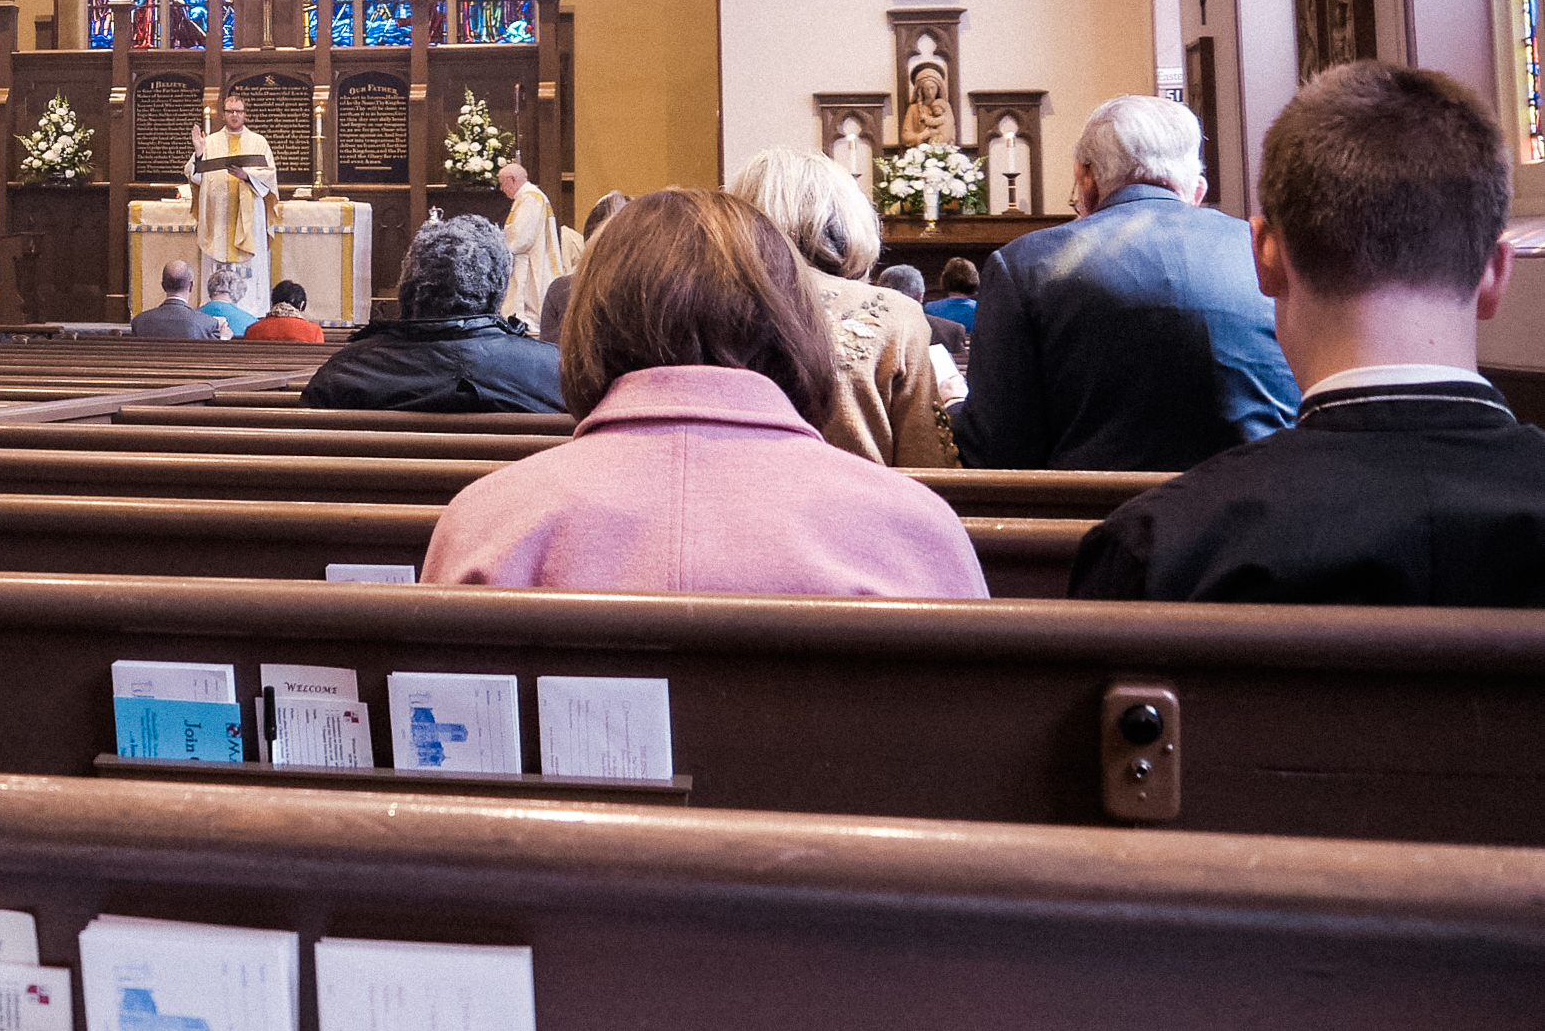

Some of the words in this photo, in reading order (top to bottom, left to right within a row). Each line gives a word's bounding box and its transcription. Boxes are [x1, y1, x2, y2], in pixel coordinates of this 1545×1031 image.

[1158, 71, 1183, 81] Easte
[284, 682, 338, 694] WELCOME
[184, 719, 202, 753] Join
